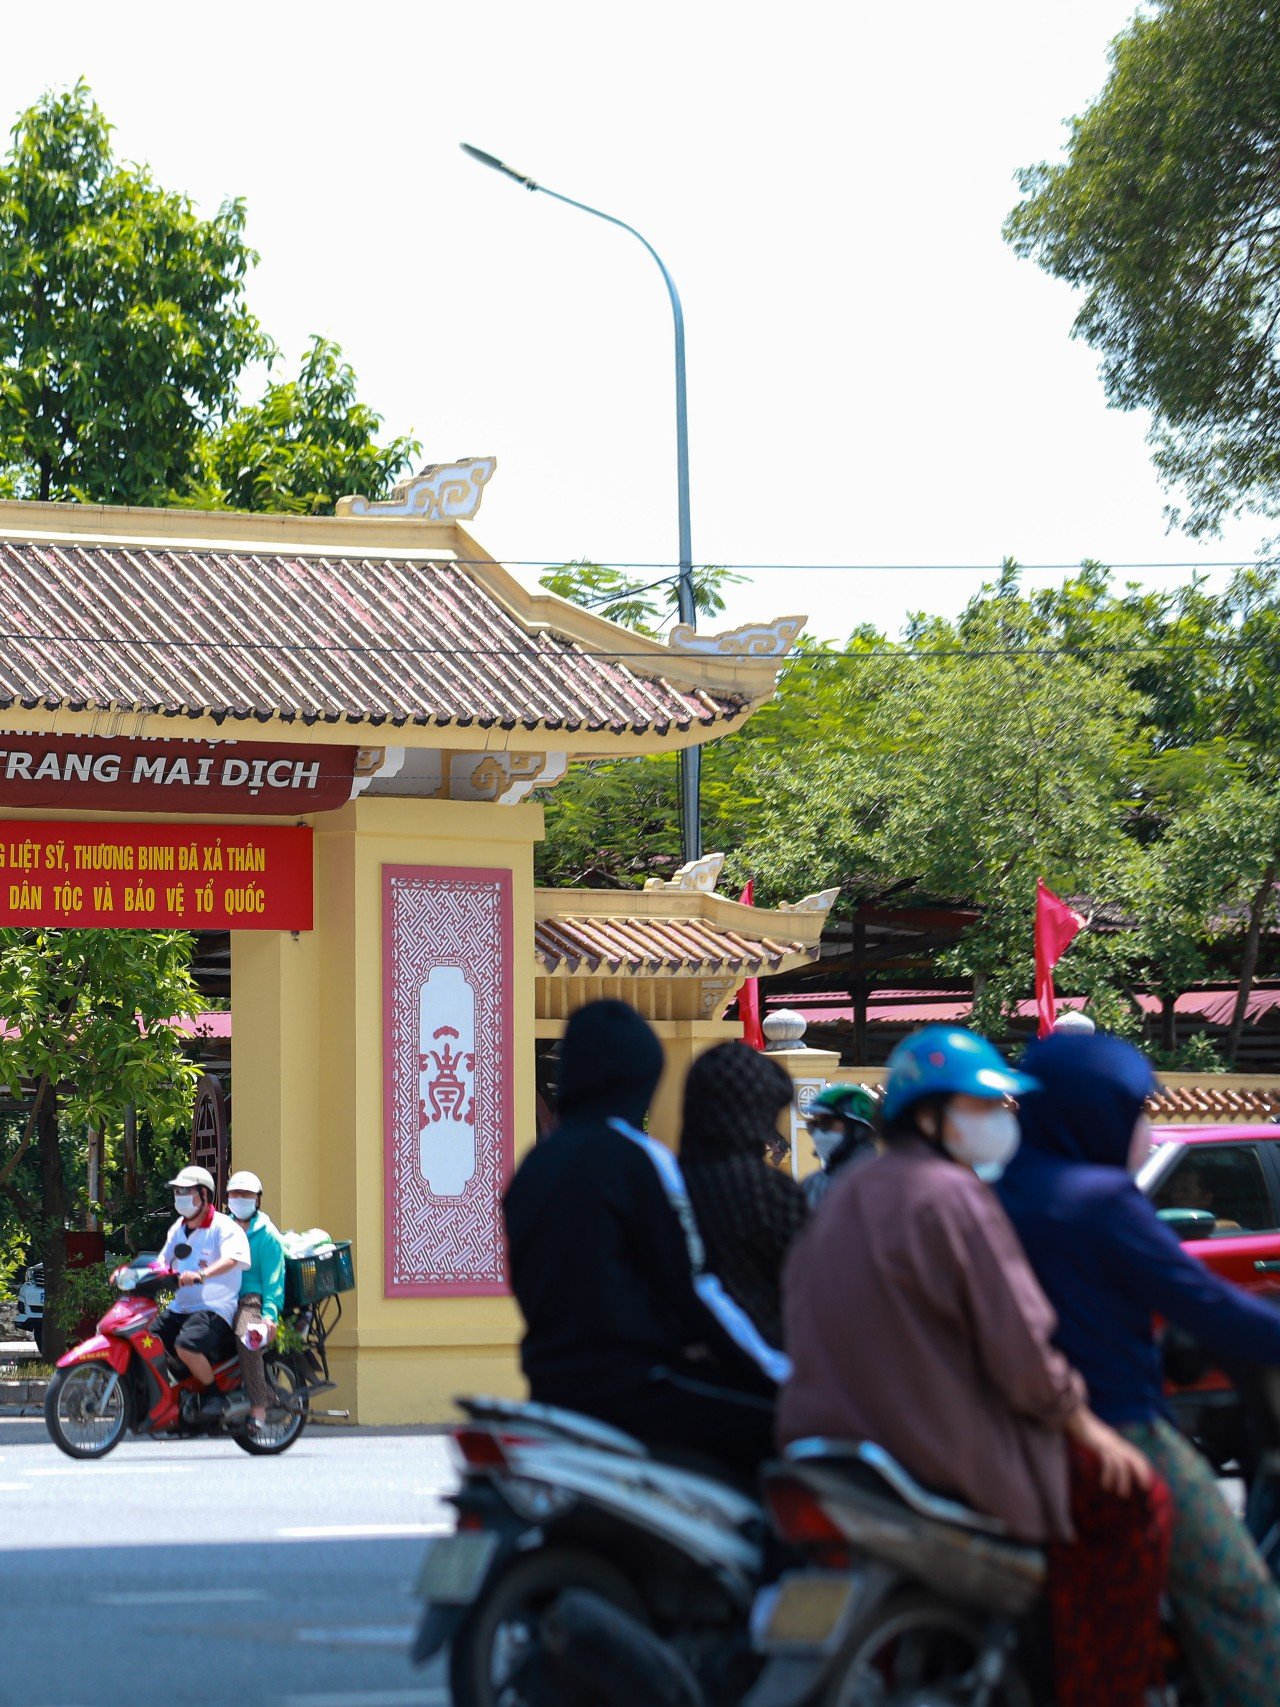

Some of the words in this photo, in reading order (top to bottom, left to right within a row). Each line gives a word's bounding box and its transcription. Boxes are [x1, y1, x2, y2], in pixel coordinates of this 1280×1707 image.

[131, 756, 215, 785] MAI
[221, 758, 320, 796] DỊCH
[10, 839, 41, 873] LIỆT
[45, 840, 69, 872] SỸ,
[73, 843, 134, 870] THƯƠNG
[138, 846, 174, 871] BINH
[178, 842, 199, 871] ĐÃ
[203, 837, 223, 871] XẢ
[226, 842, 265, 871] THÂN
[9, 880, 42, 910] DÂN
[53, 881, 83, 916] TỘC
[93, 881, 114, 911] VÀ
[124, 878, 155, 912] BẢO
[166, 882, 185, 917] VỆ
[195, 878, 214, 912] TỔ
[224, 880, 265, 915] QUỐC
